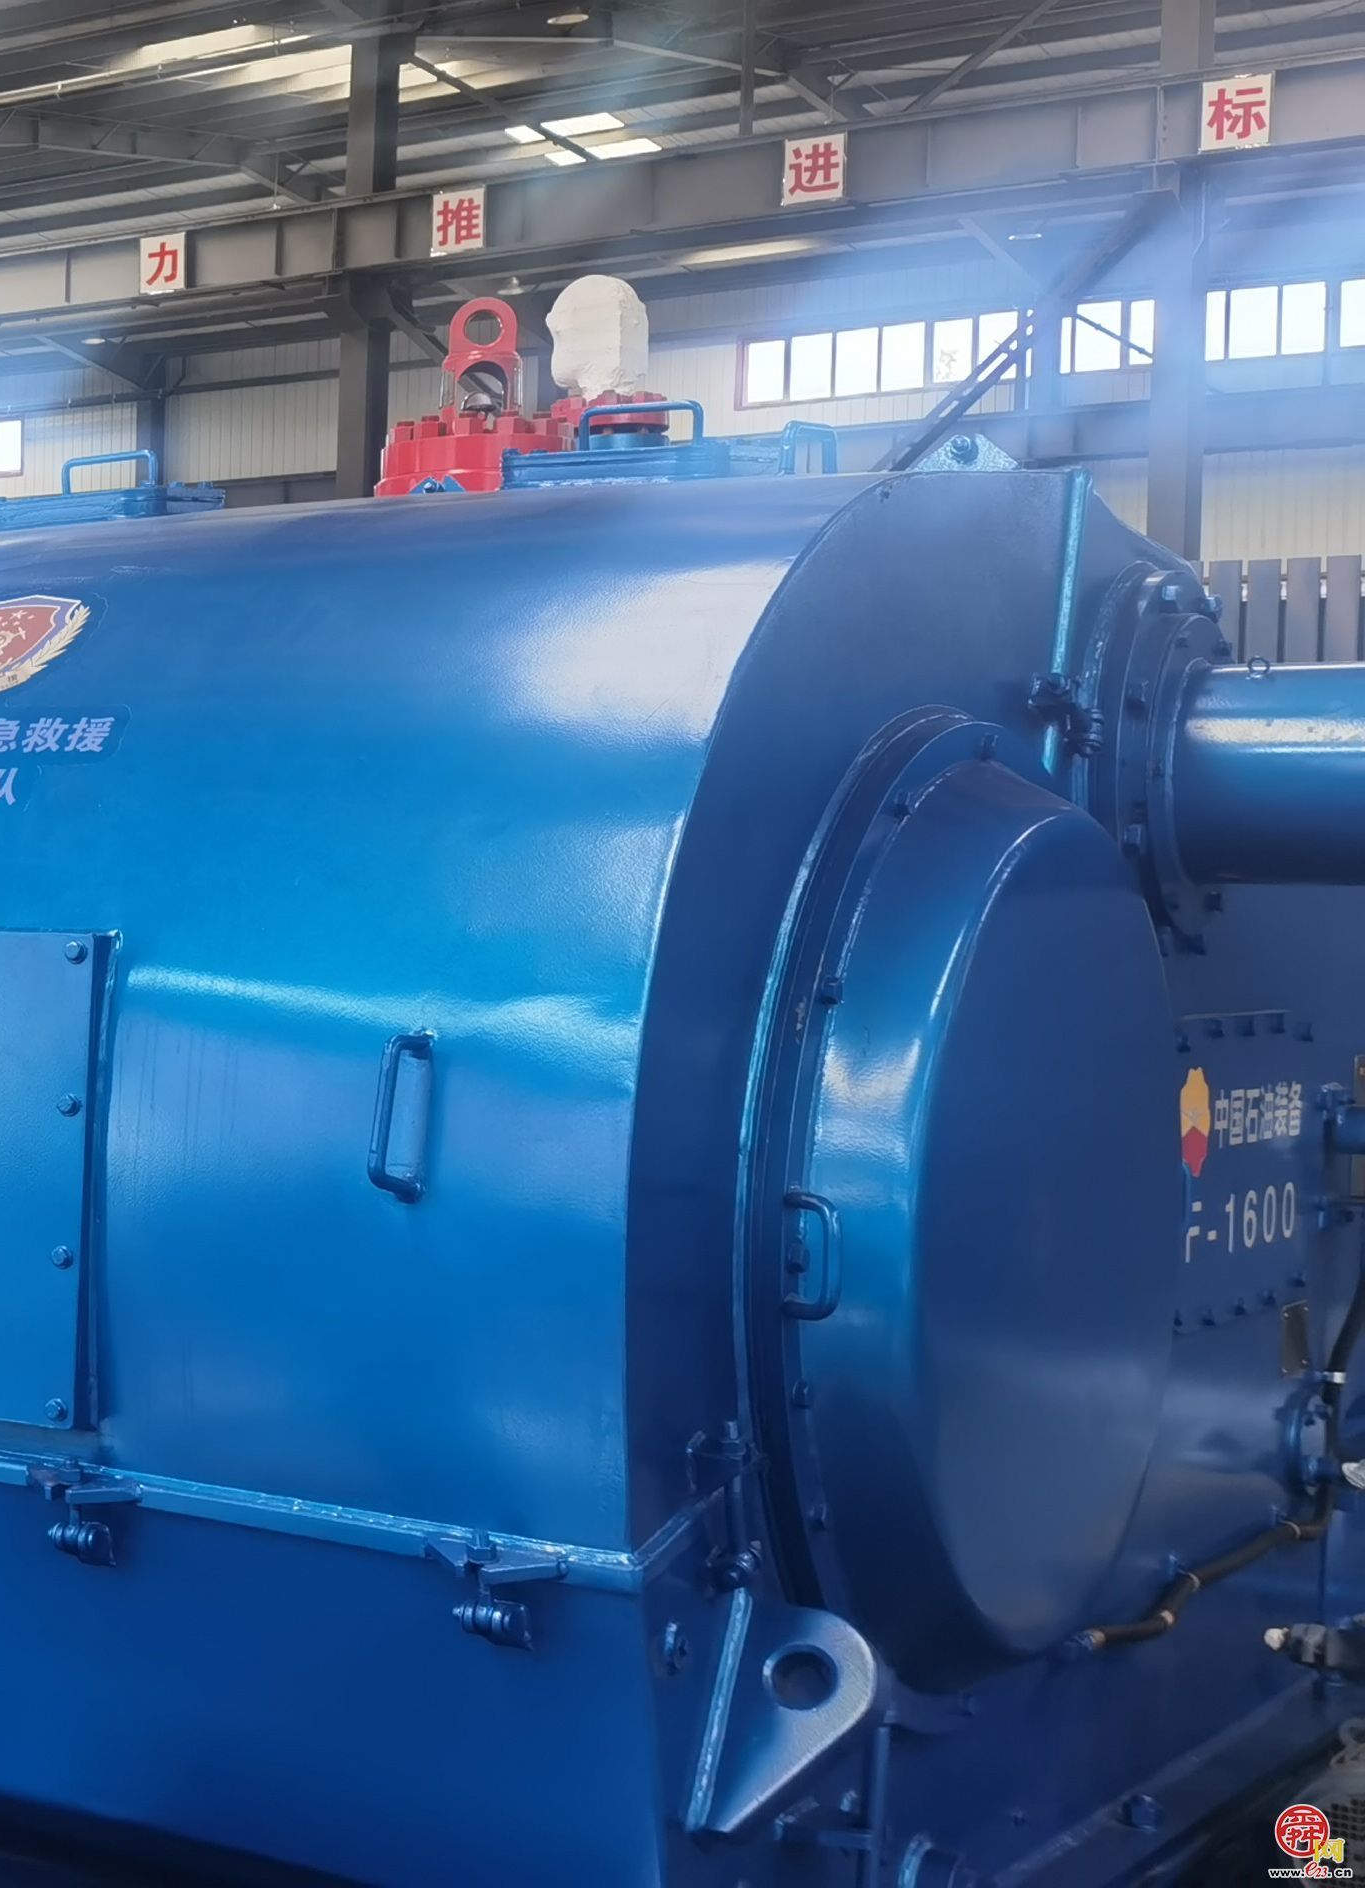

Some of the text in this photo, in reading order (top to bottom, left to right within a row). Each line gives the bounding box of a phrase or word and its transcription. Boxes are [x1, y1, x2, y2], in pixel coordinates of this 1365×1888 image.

[145, 242, 180, 286] 力
[436, 197, 482, 247] 推
[788, 142, 841, 195] 进
[1206, 87, 1267, 141] 标
[1214, 1081, 1302, 1149] 中国石油装备
[1185, 1182, 1295, 1263] F-1600
